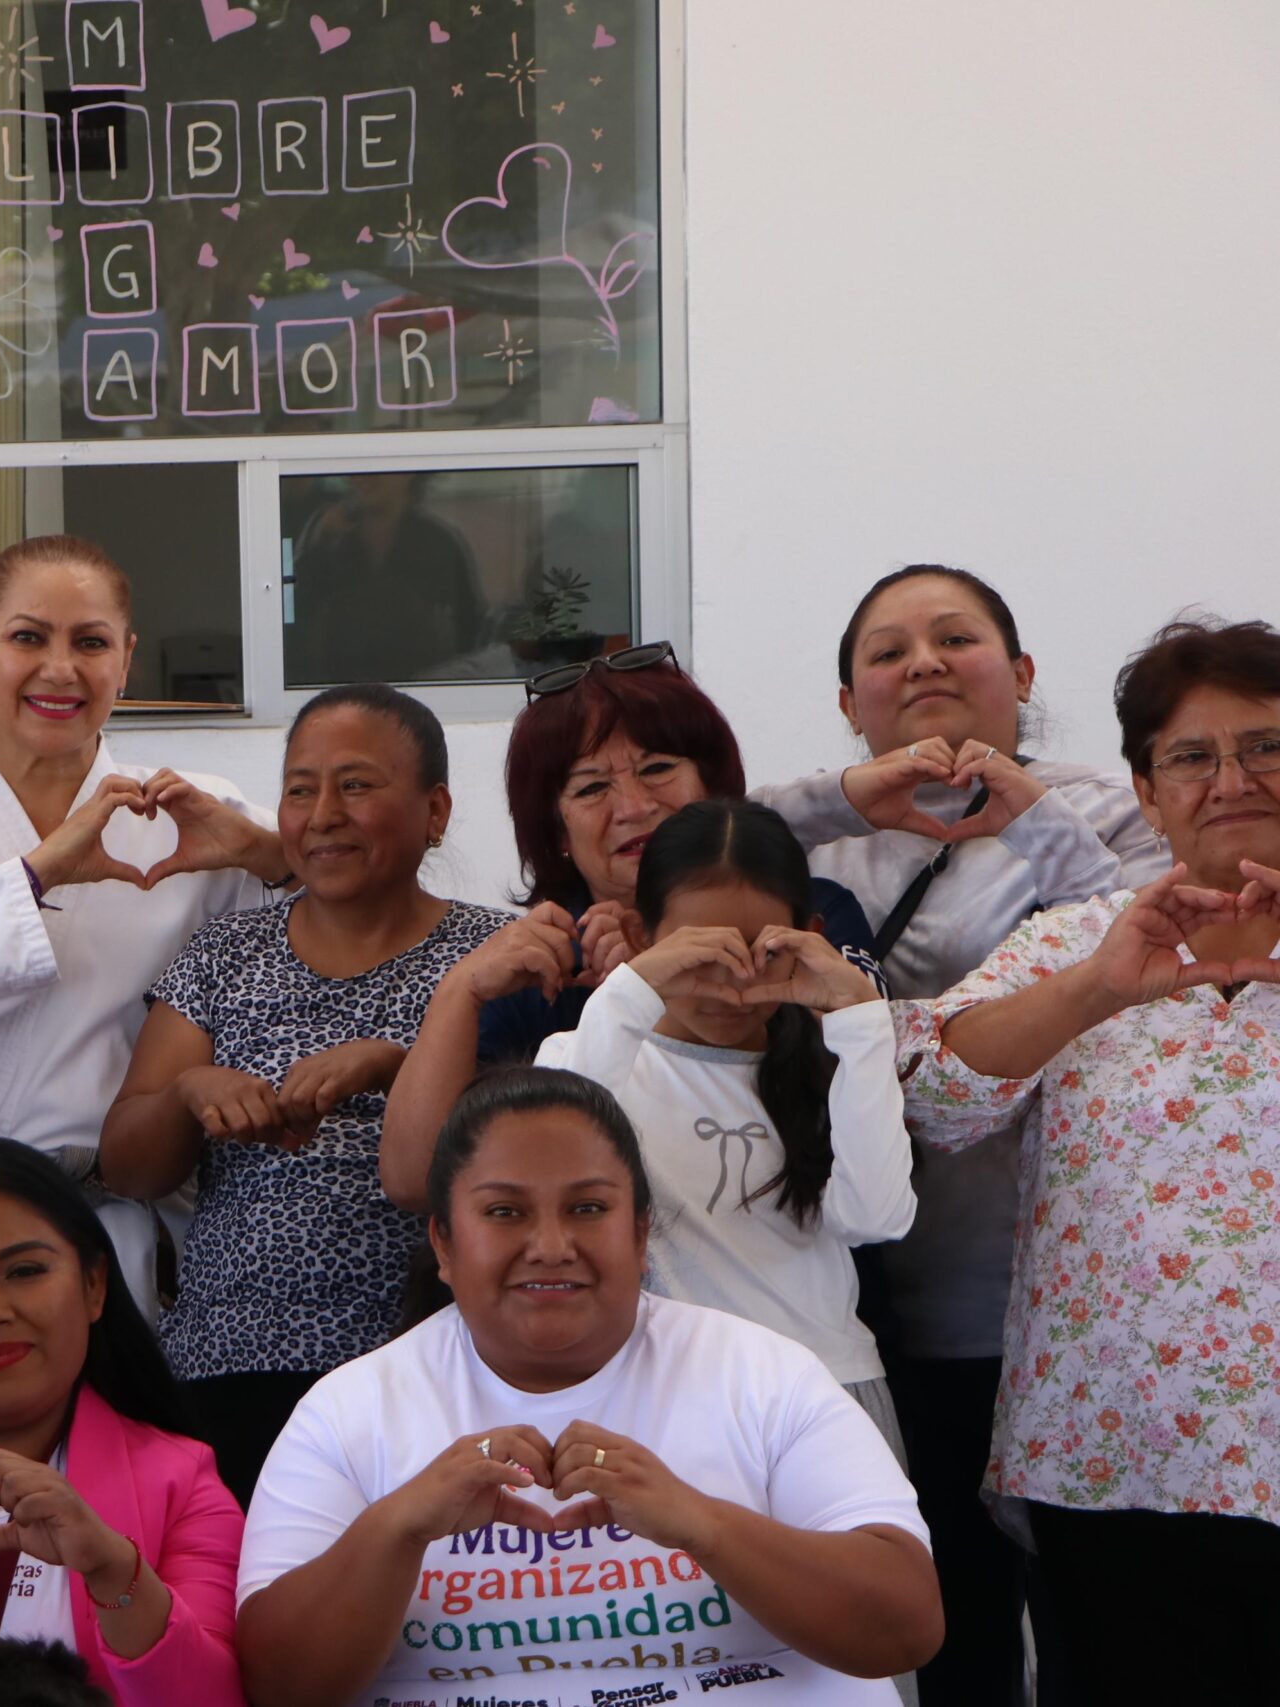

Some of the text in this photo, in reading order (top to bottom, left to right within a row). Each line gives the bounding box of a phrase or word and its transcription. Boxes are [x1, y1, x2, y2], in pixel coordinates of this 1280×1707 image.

[1, 113, 398, 181] LIBRE
[95, 327, 435, 401] AMOR
[402, 1582, 733, 1652] comunidad
[591, 1681, 665, 1704] Pensar
[700, 1666, 785, 1693] PUEBLA
